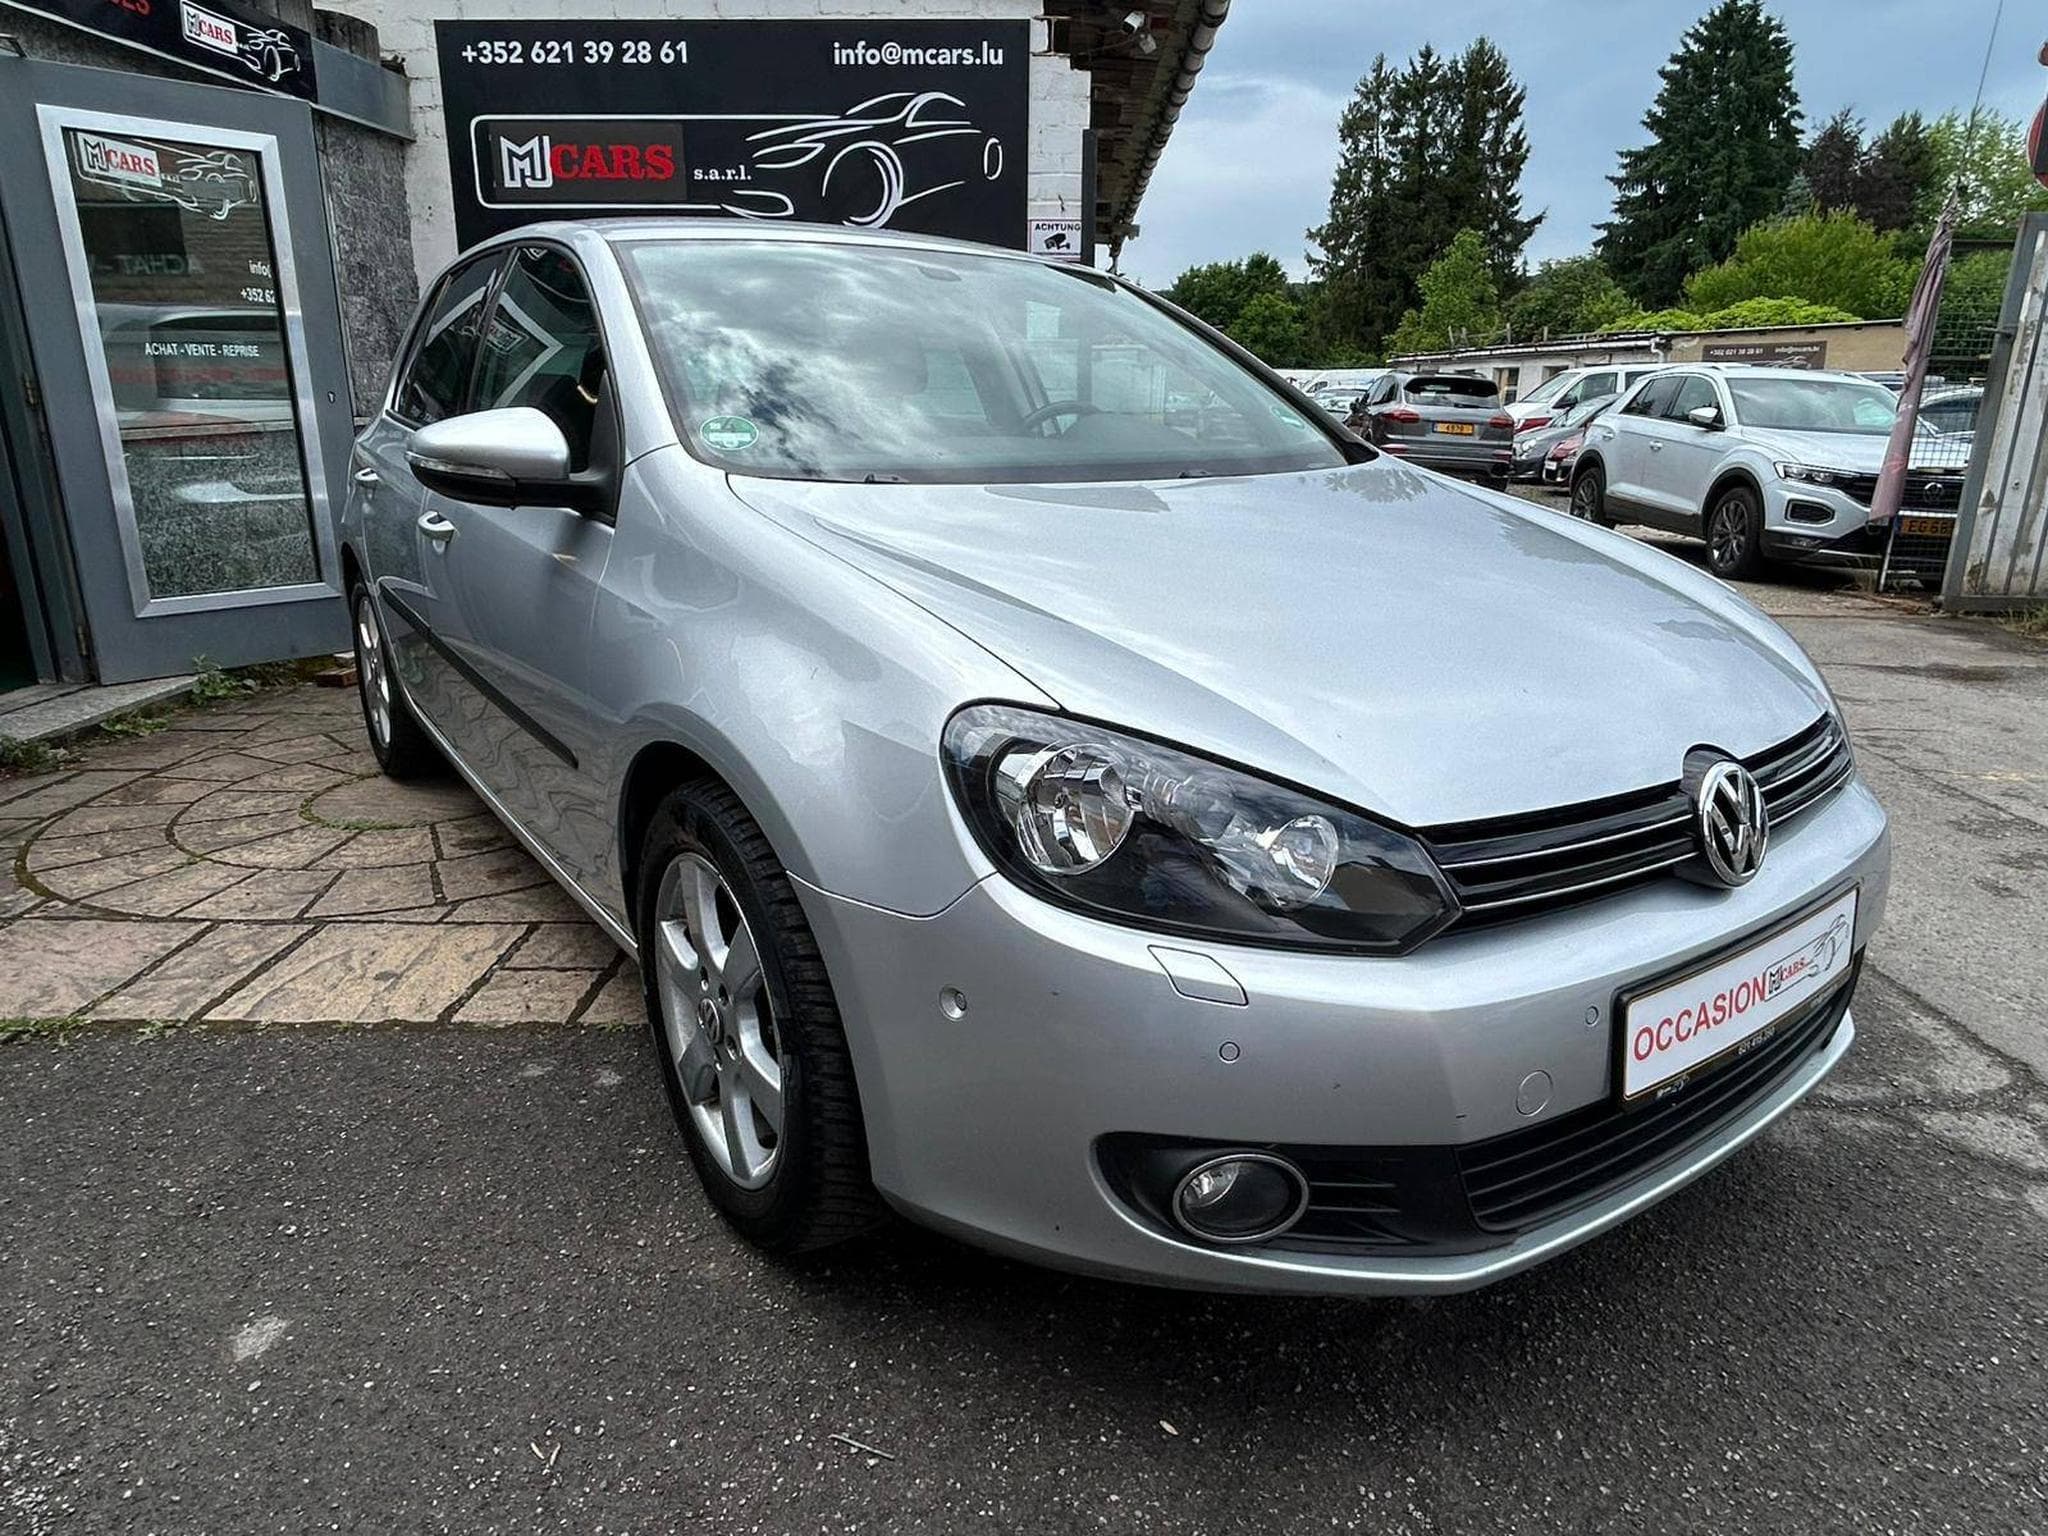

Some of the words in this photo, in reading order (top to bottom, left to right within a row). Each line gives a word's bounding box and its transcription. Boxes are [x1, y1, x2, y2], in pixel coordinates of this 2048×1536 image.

[462, 41, 524, 64] +352
[530, 41, 575, 64] 621
[583, 41, 614, 64] 39
[621, 41, 652, 64] 28
[659, 41, 688, 64] 61
[833, 40, 1004, 65] info@mcars.lu
[1034, 223, 1081, 231] ACHTUNG
[249, 260, 272, 278] info
[241, 288, 264, 302] +352
[145, 343, 178, 355] ACHAT
[185, 344, 217, 356] VENTE
[223, 345, 260, 357] REPRISE
[1633, 972, 1767, 1062] OCCASION
